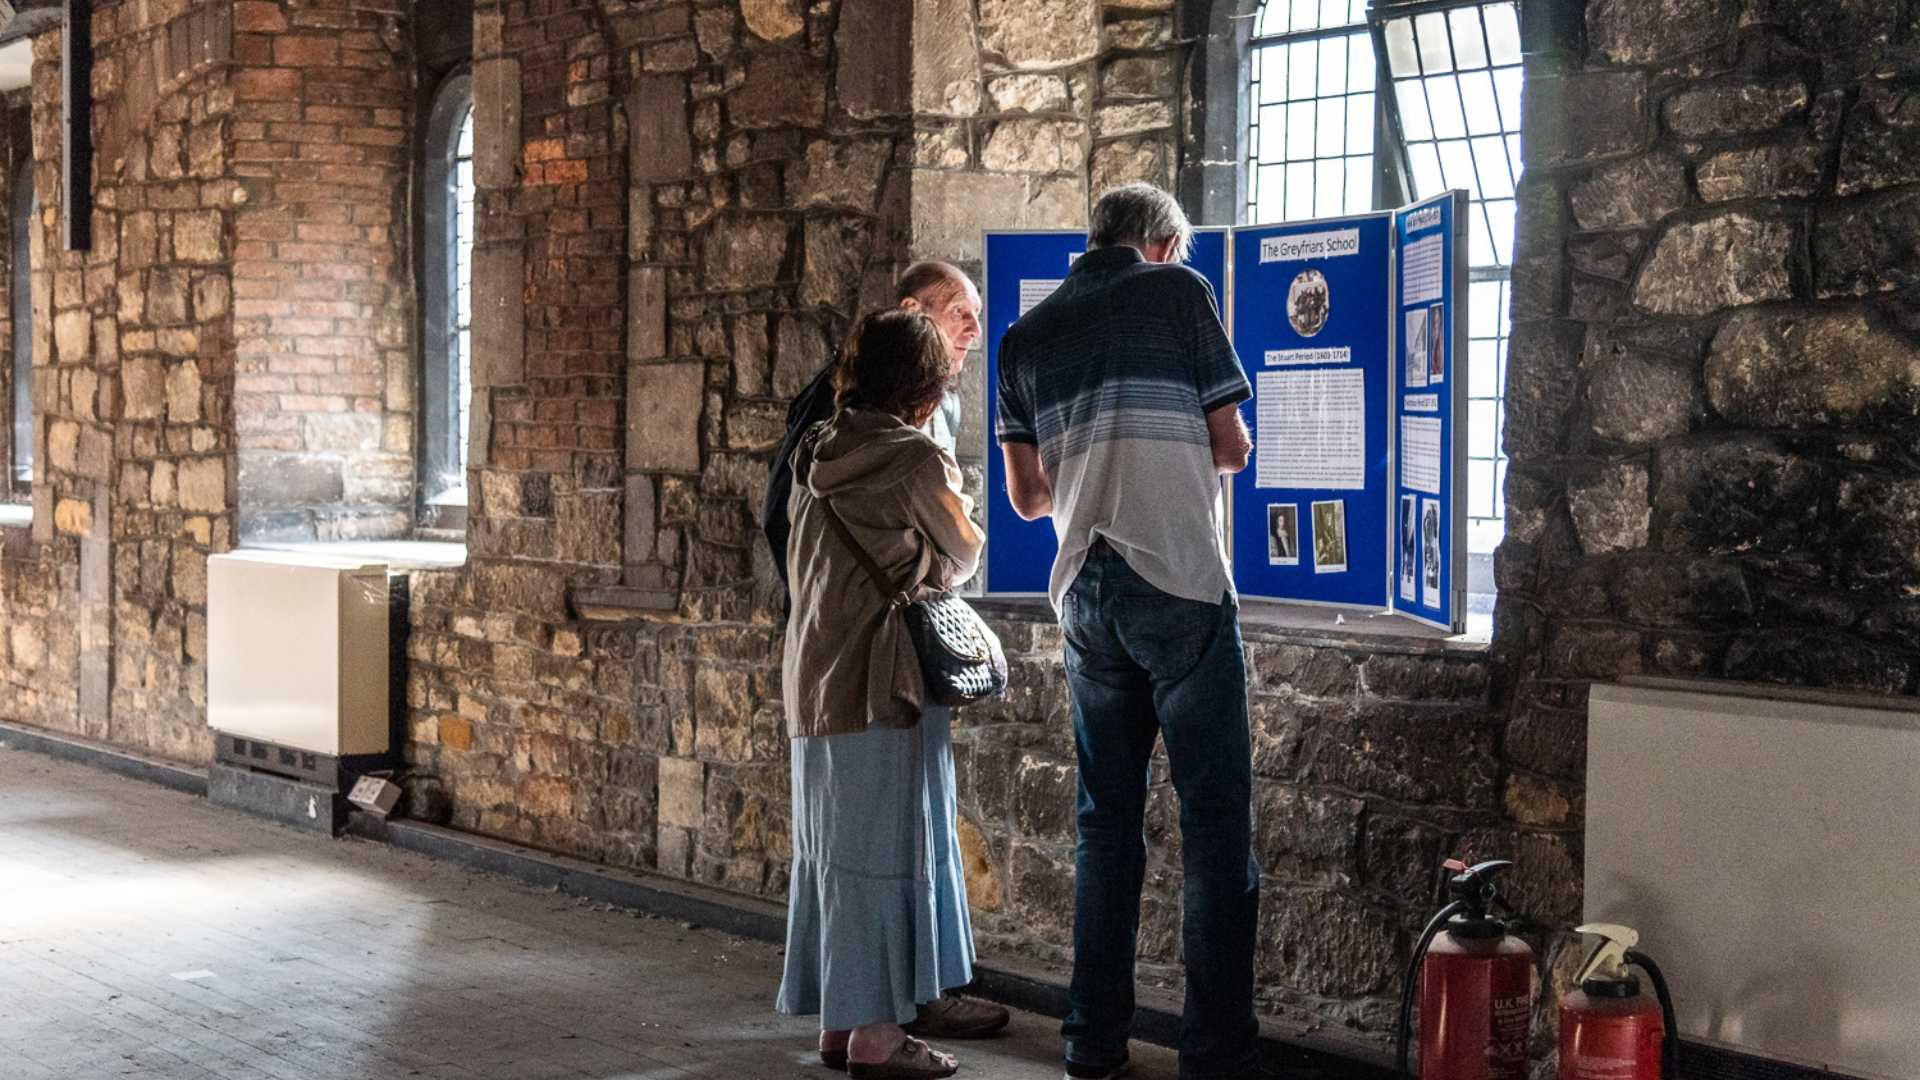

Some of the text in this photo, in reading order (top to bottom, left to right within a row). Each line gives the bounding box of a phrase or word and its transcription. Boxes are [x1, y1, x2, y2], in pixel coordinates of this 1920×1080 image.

[1263, 235, 1358, 257] The Greyfriars School
[1295, 352, 1313, 360] Period
